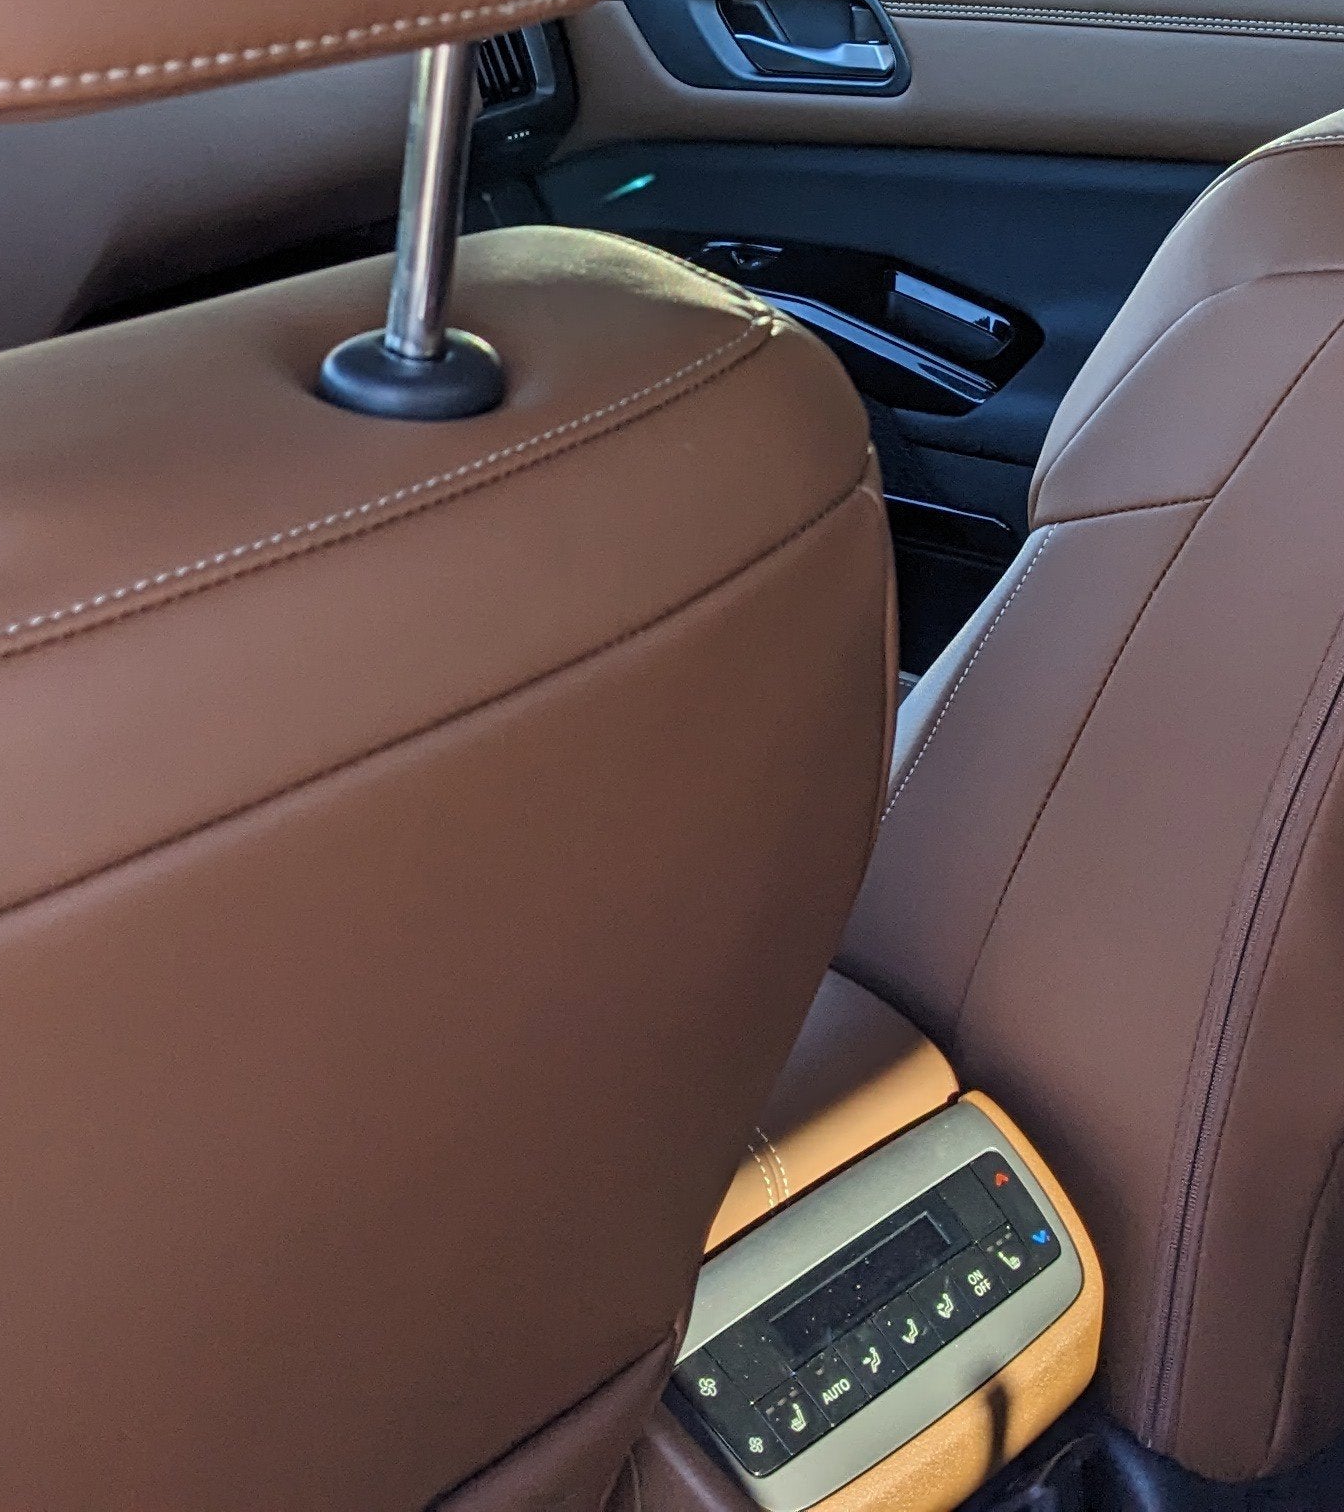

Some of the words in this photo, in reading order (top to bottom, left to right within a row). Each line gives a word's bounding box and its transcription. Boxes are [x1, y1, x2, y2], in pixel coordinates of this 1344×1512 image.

[967, 1269, 984, 1286] ON
[973, 1277, 992, 1298] OFF
[821, 1377, 852, 1406] AUTO
